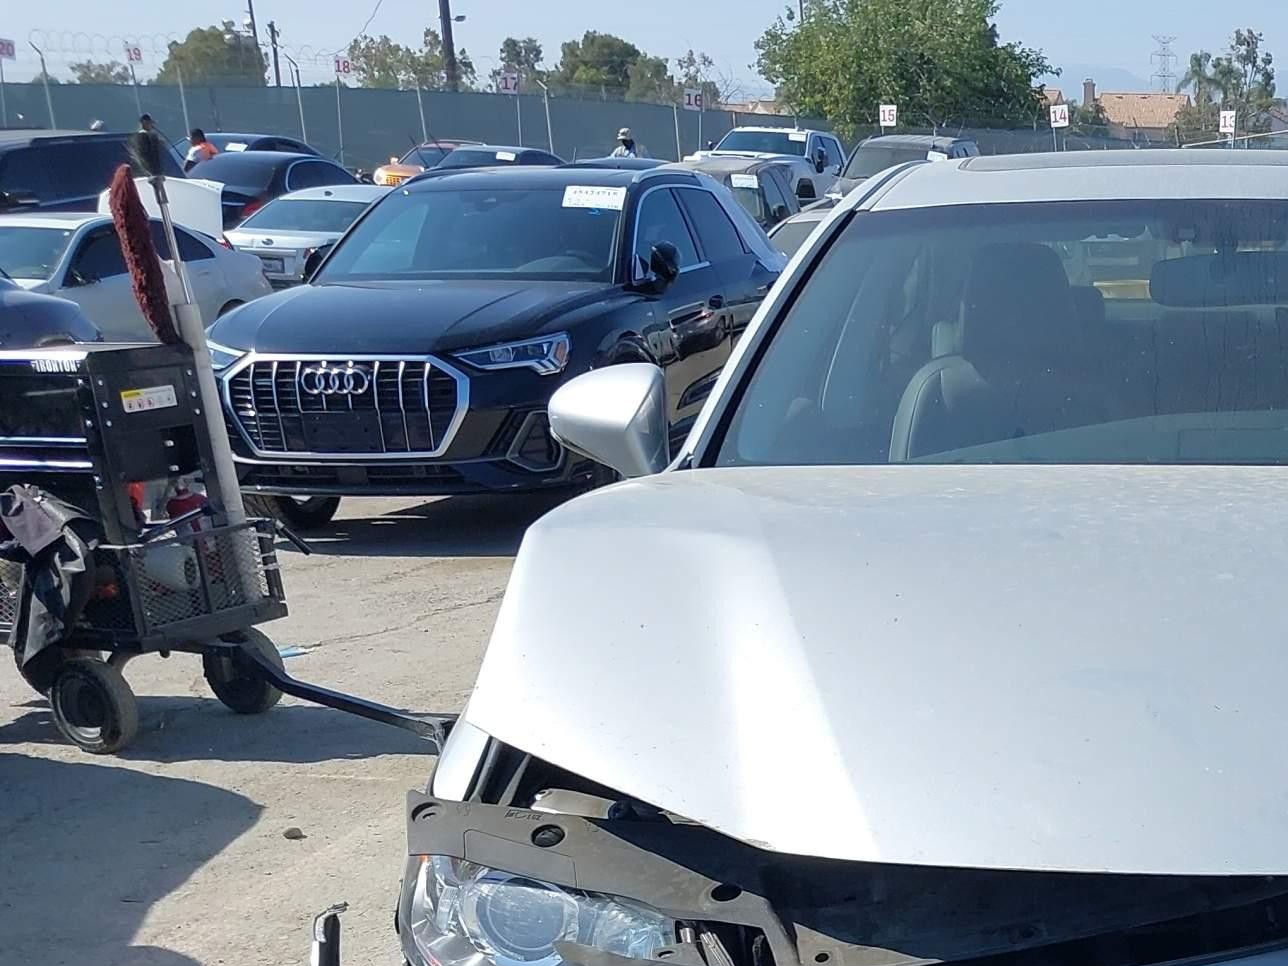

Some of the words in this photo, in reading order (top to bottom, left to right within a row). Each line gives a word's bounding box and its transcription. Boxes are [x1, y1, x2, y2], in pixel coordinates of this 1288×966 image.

[127, 47, 142, 61] 19
[335, 60, 350, 73] 18
[501, 76, 517, 91] 17
[685, 93, 703, 107] 16
[881, 109, 895, 122] 15
[1051, 109, 1068, 123] 14
[35, 359, 78, 373] IRONTON
